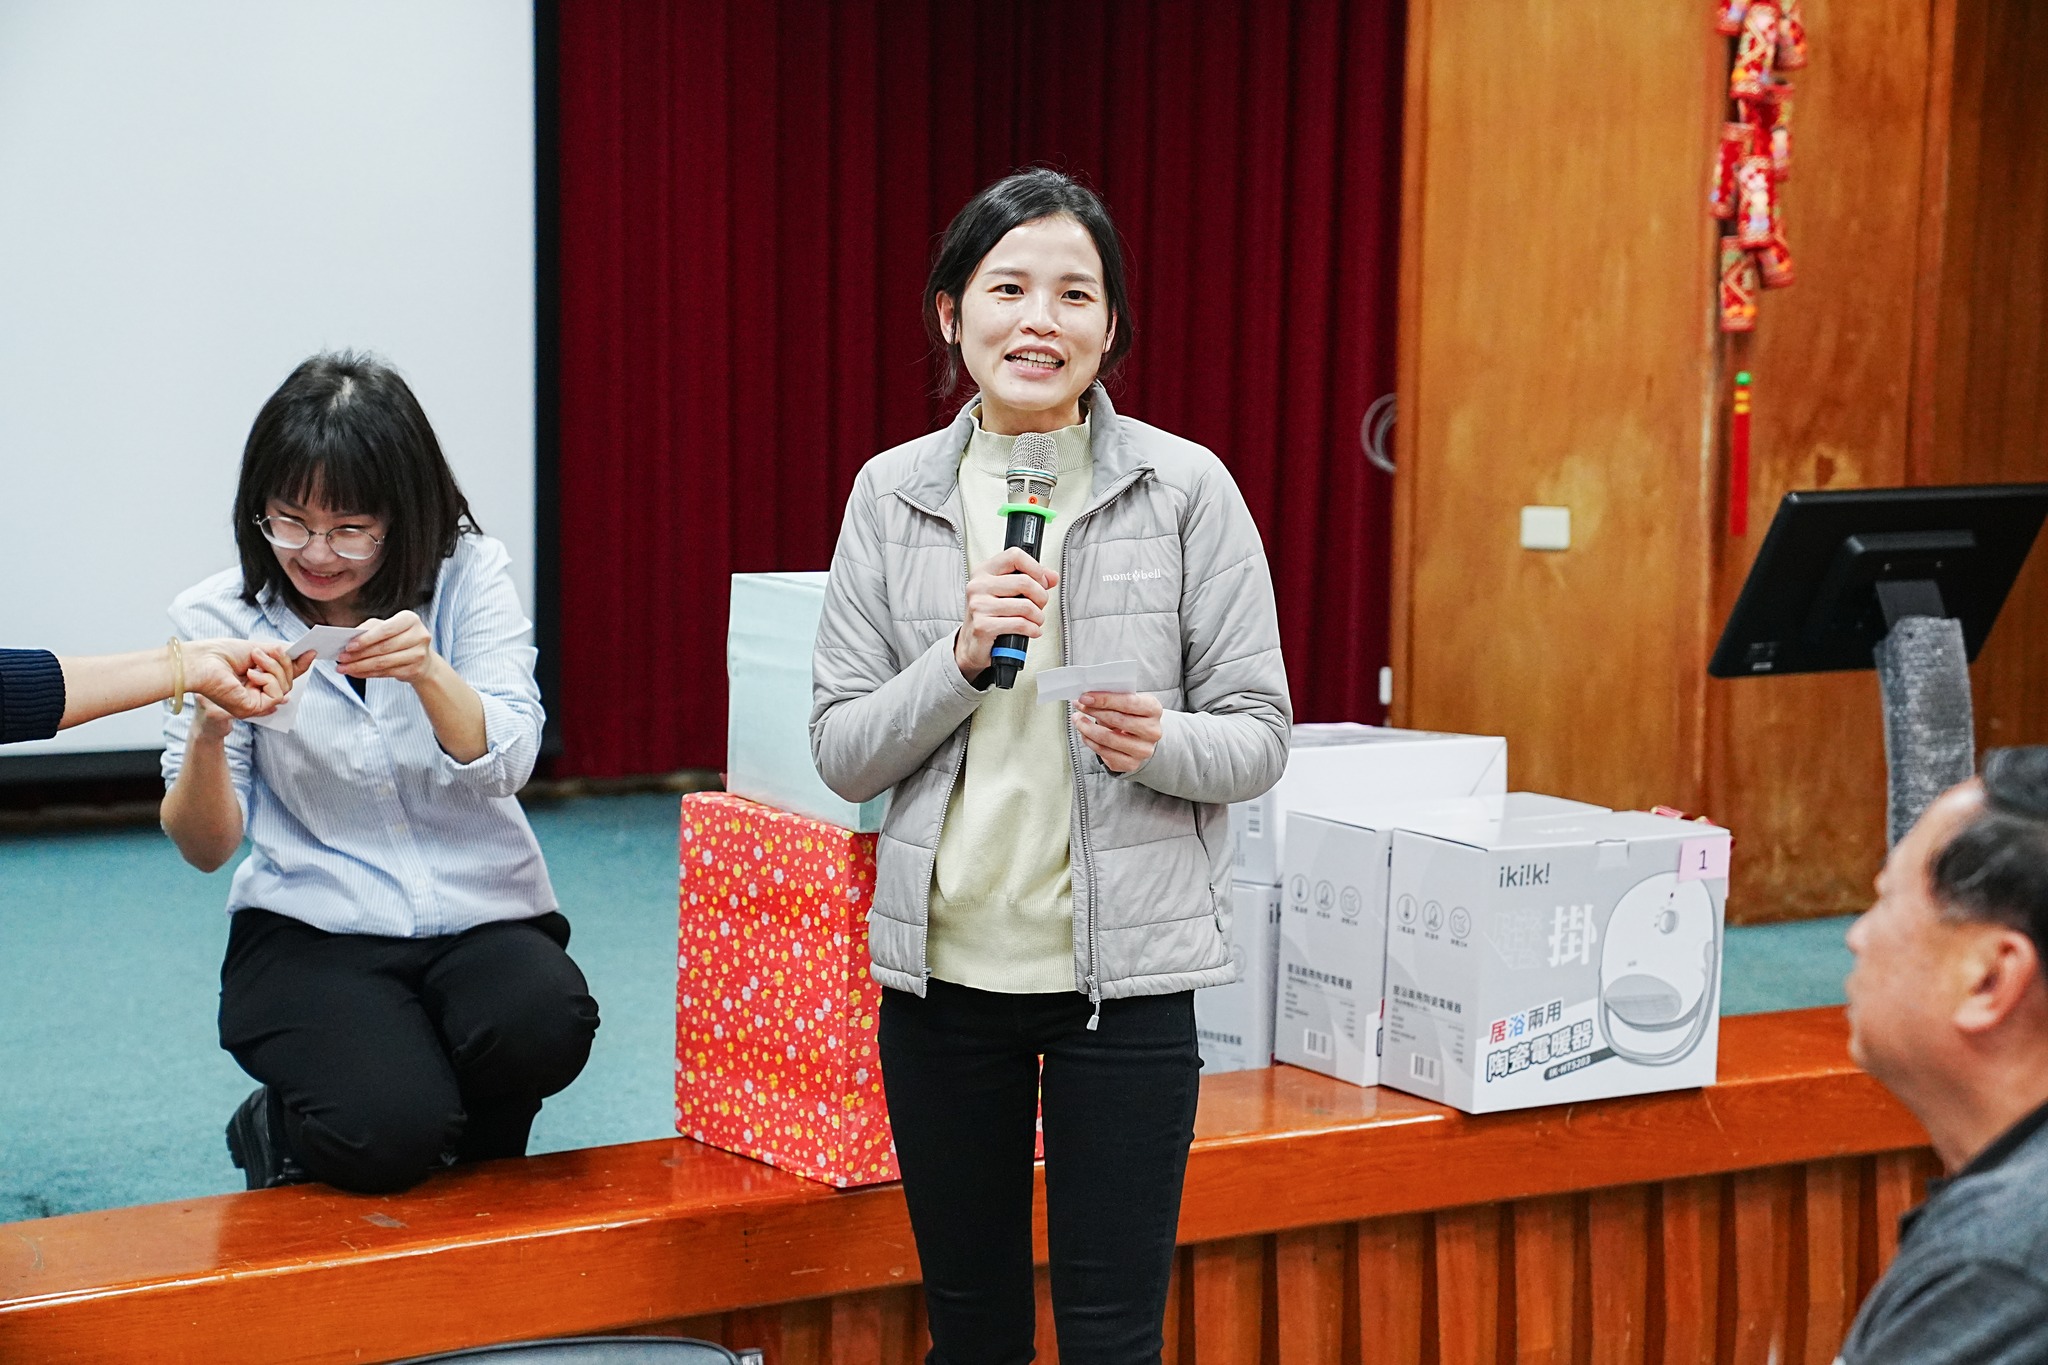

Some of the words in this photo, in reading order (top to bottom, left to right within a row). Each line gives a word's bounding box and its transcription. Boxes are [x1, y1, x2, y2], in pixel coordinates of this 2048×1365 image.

[1698, 849, 1708, 871] 1
[1489, 999, 1562, 1045] 居浴兩用
[1486, 1018, 1594, 1083] 陶瓷電暖器
